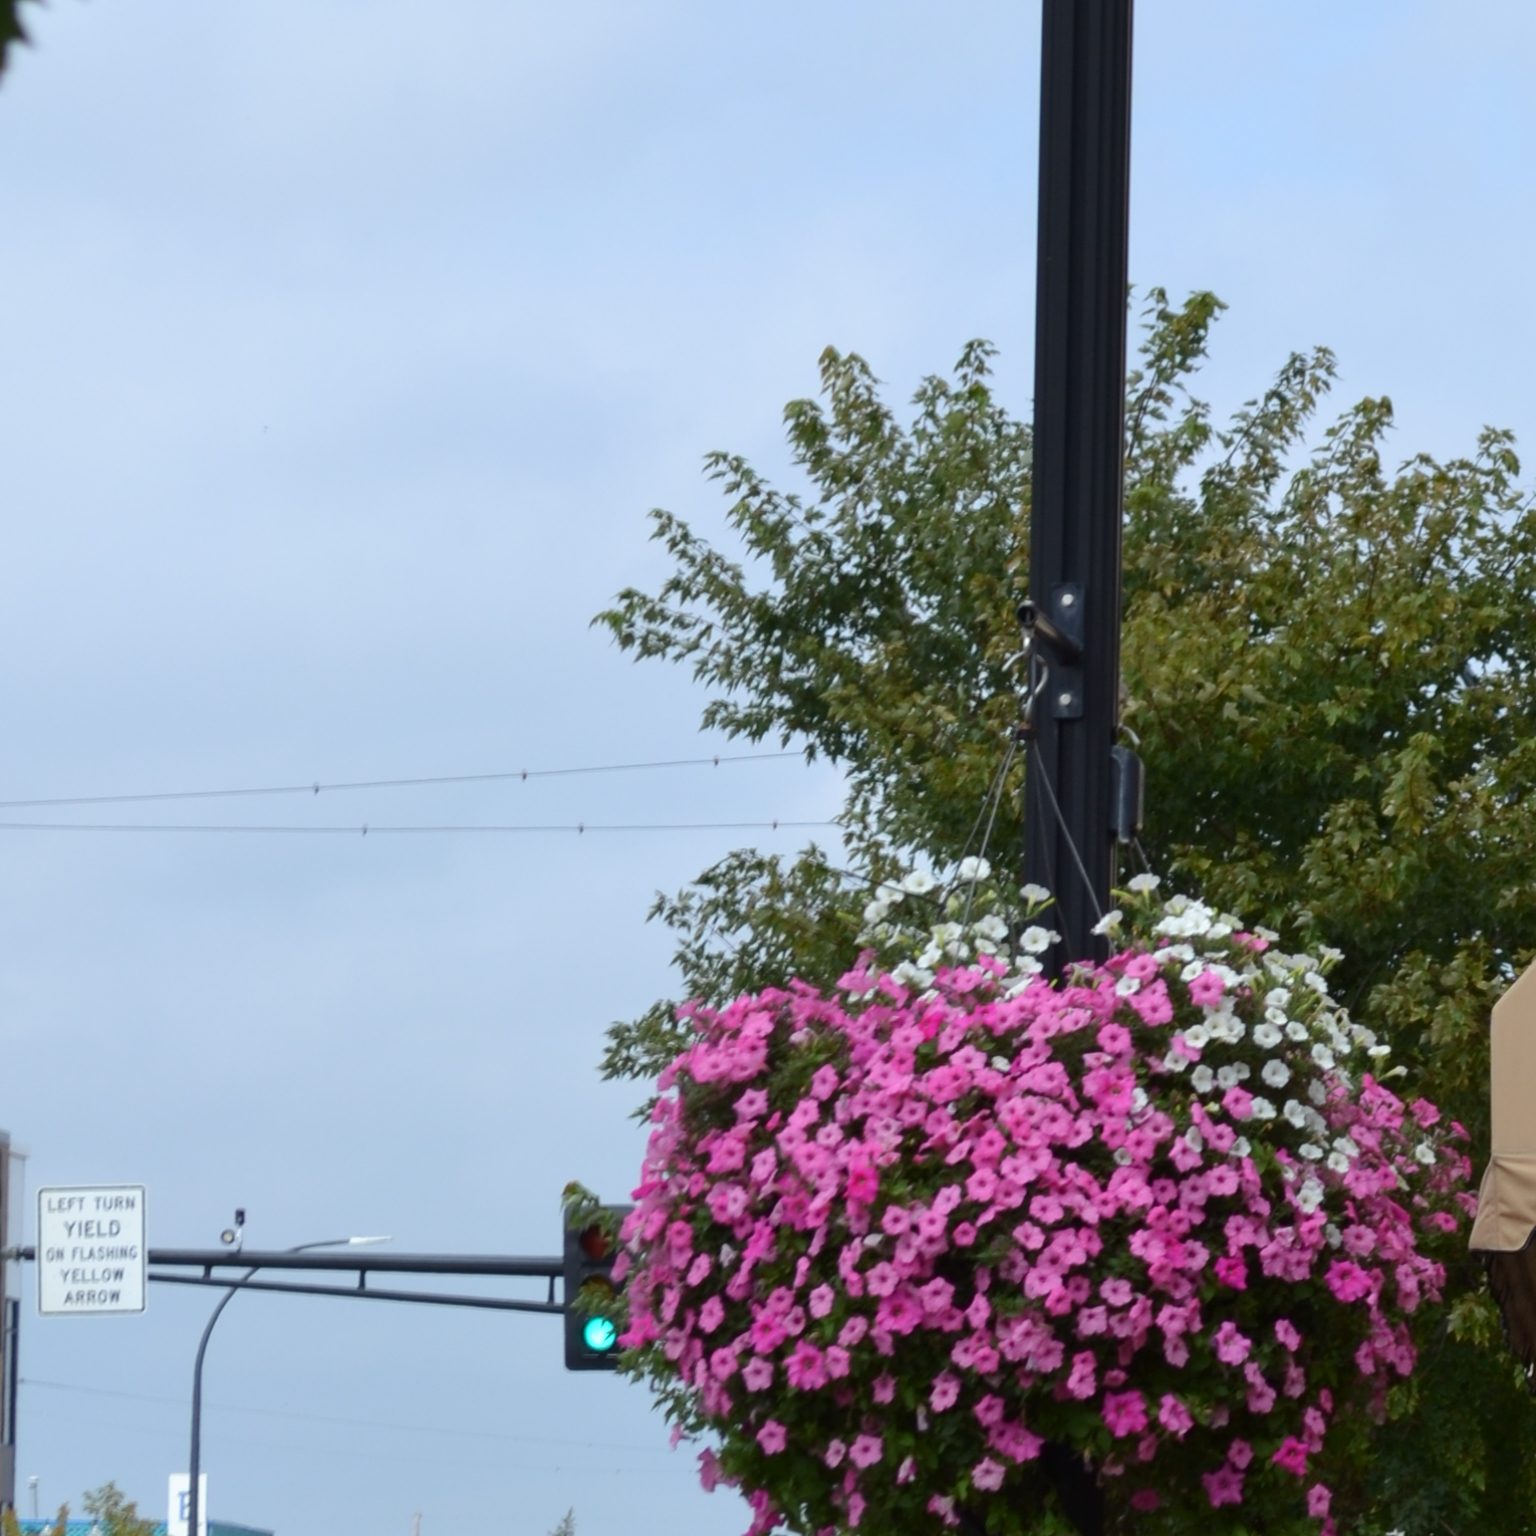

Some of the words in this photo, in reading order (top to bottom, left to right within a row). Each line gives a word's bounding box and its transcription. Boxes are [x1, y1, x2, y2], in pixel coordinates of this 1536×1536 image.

[47, 1196, 85, 1213] LEFT
[95, 1195, 136, 1212] TURN
[64, 1219, 121, 1238] YIELD
[46, 1247, 65, 1263] ON
[72, 1245, 138, 1263] FLASHING
[60, 1267, 125, 1284] YELLOW
[64, 1289, 121, 1306] ARROW
